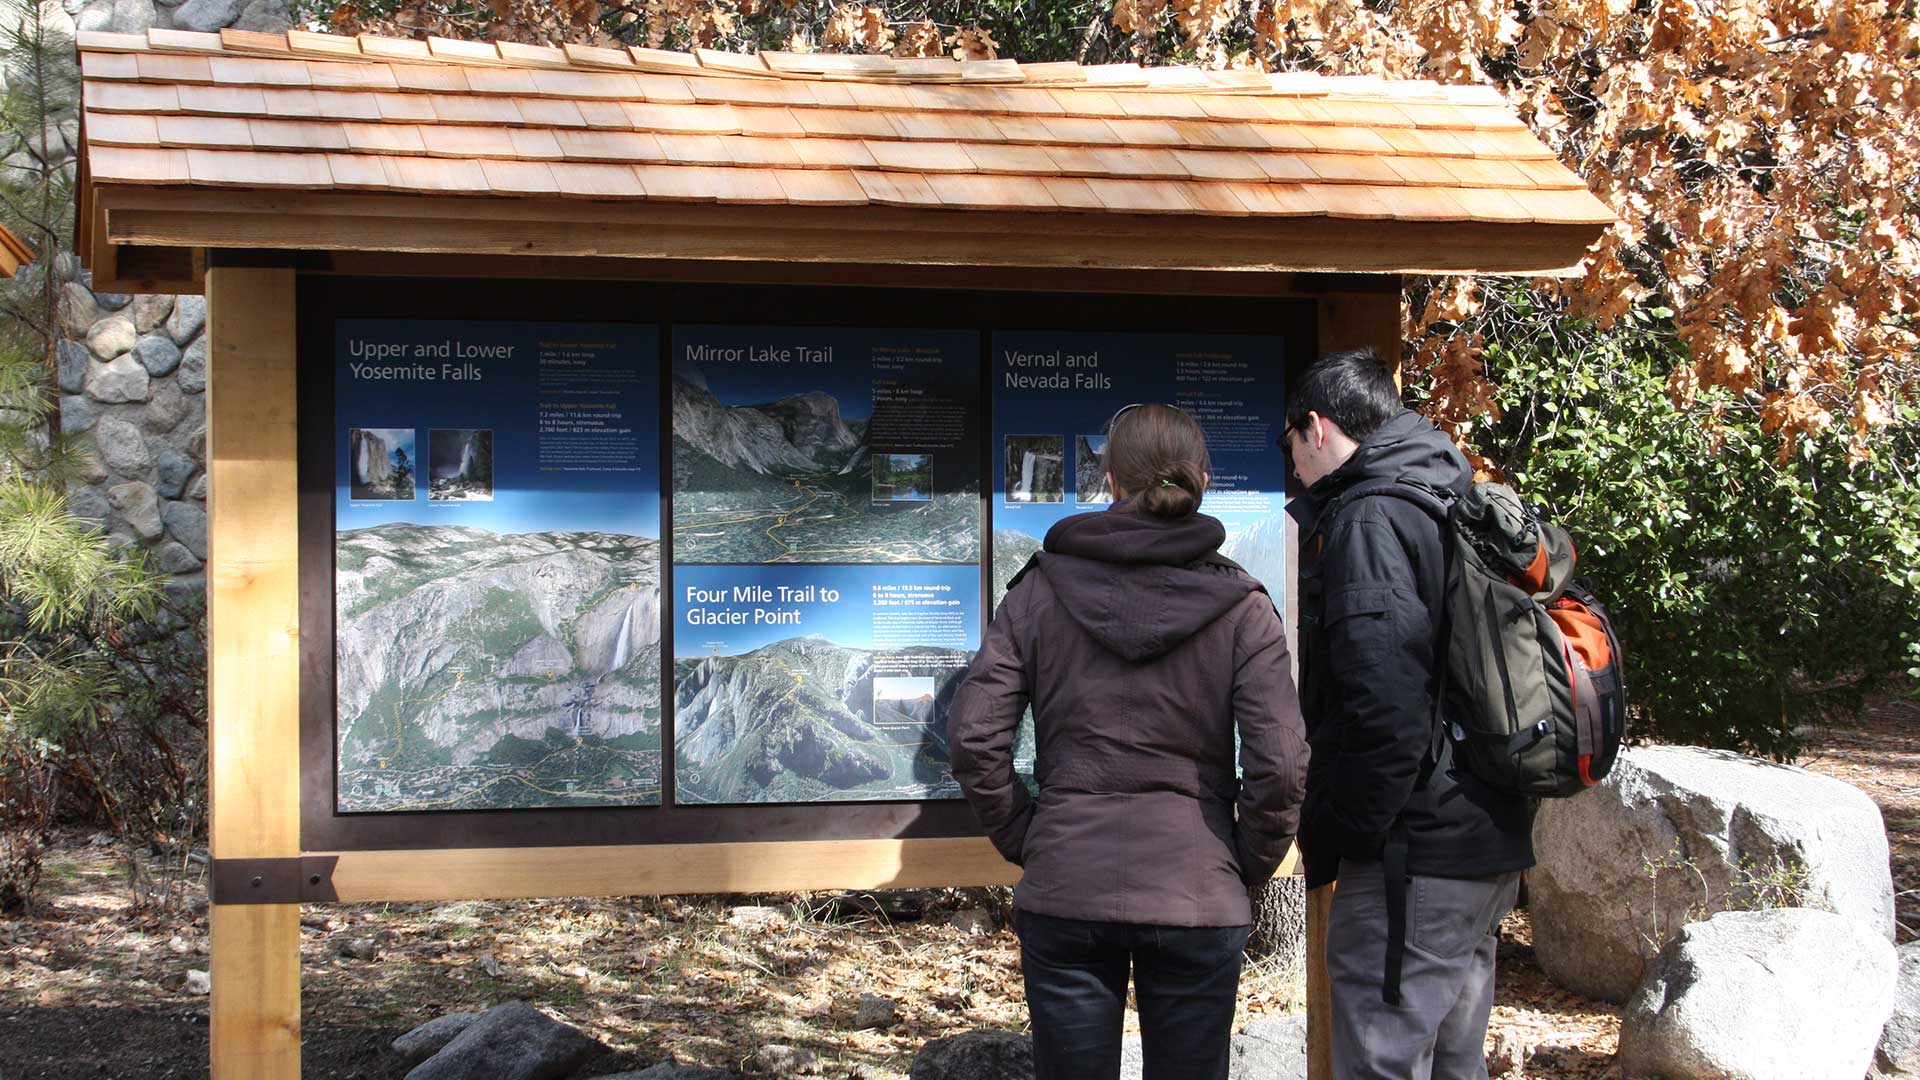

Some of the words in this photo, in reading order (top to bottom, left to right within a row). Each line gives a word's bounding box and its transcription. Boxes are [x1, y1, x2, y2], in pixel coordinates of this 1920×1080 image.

[350, 339, 409, 361] Upper
[414, 339, 450, 358] and
[456, 341, 515, 359] Lower
[686, 344, 745, 361] Mirror
[750, 345, 791, 362] Lake
[795, 346, 833, 363] Trail
[1004, 350, 1060, 367] Vernal
[1065, 351, 1098, 367] and
[349, 362, 437, 380] Yosemite
[442, 362, 482, 380] Falls
[1005, 372, 1069, 389] Nevada
[1075, 372, 1111, 389] Falls
[686, 586, 728, 603] Four
[733, 586, 773, 603] Mile
[777, 585, 815, 602] Trail
[820, 587, 840, 602] to
[686, 608, 749, 625] Glacier
[754, 608, 801, 625] Point
